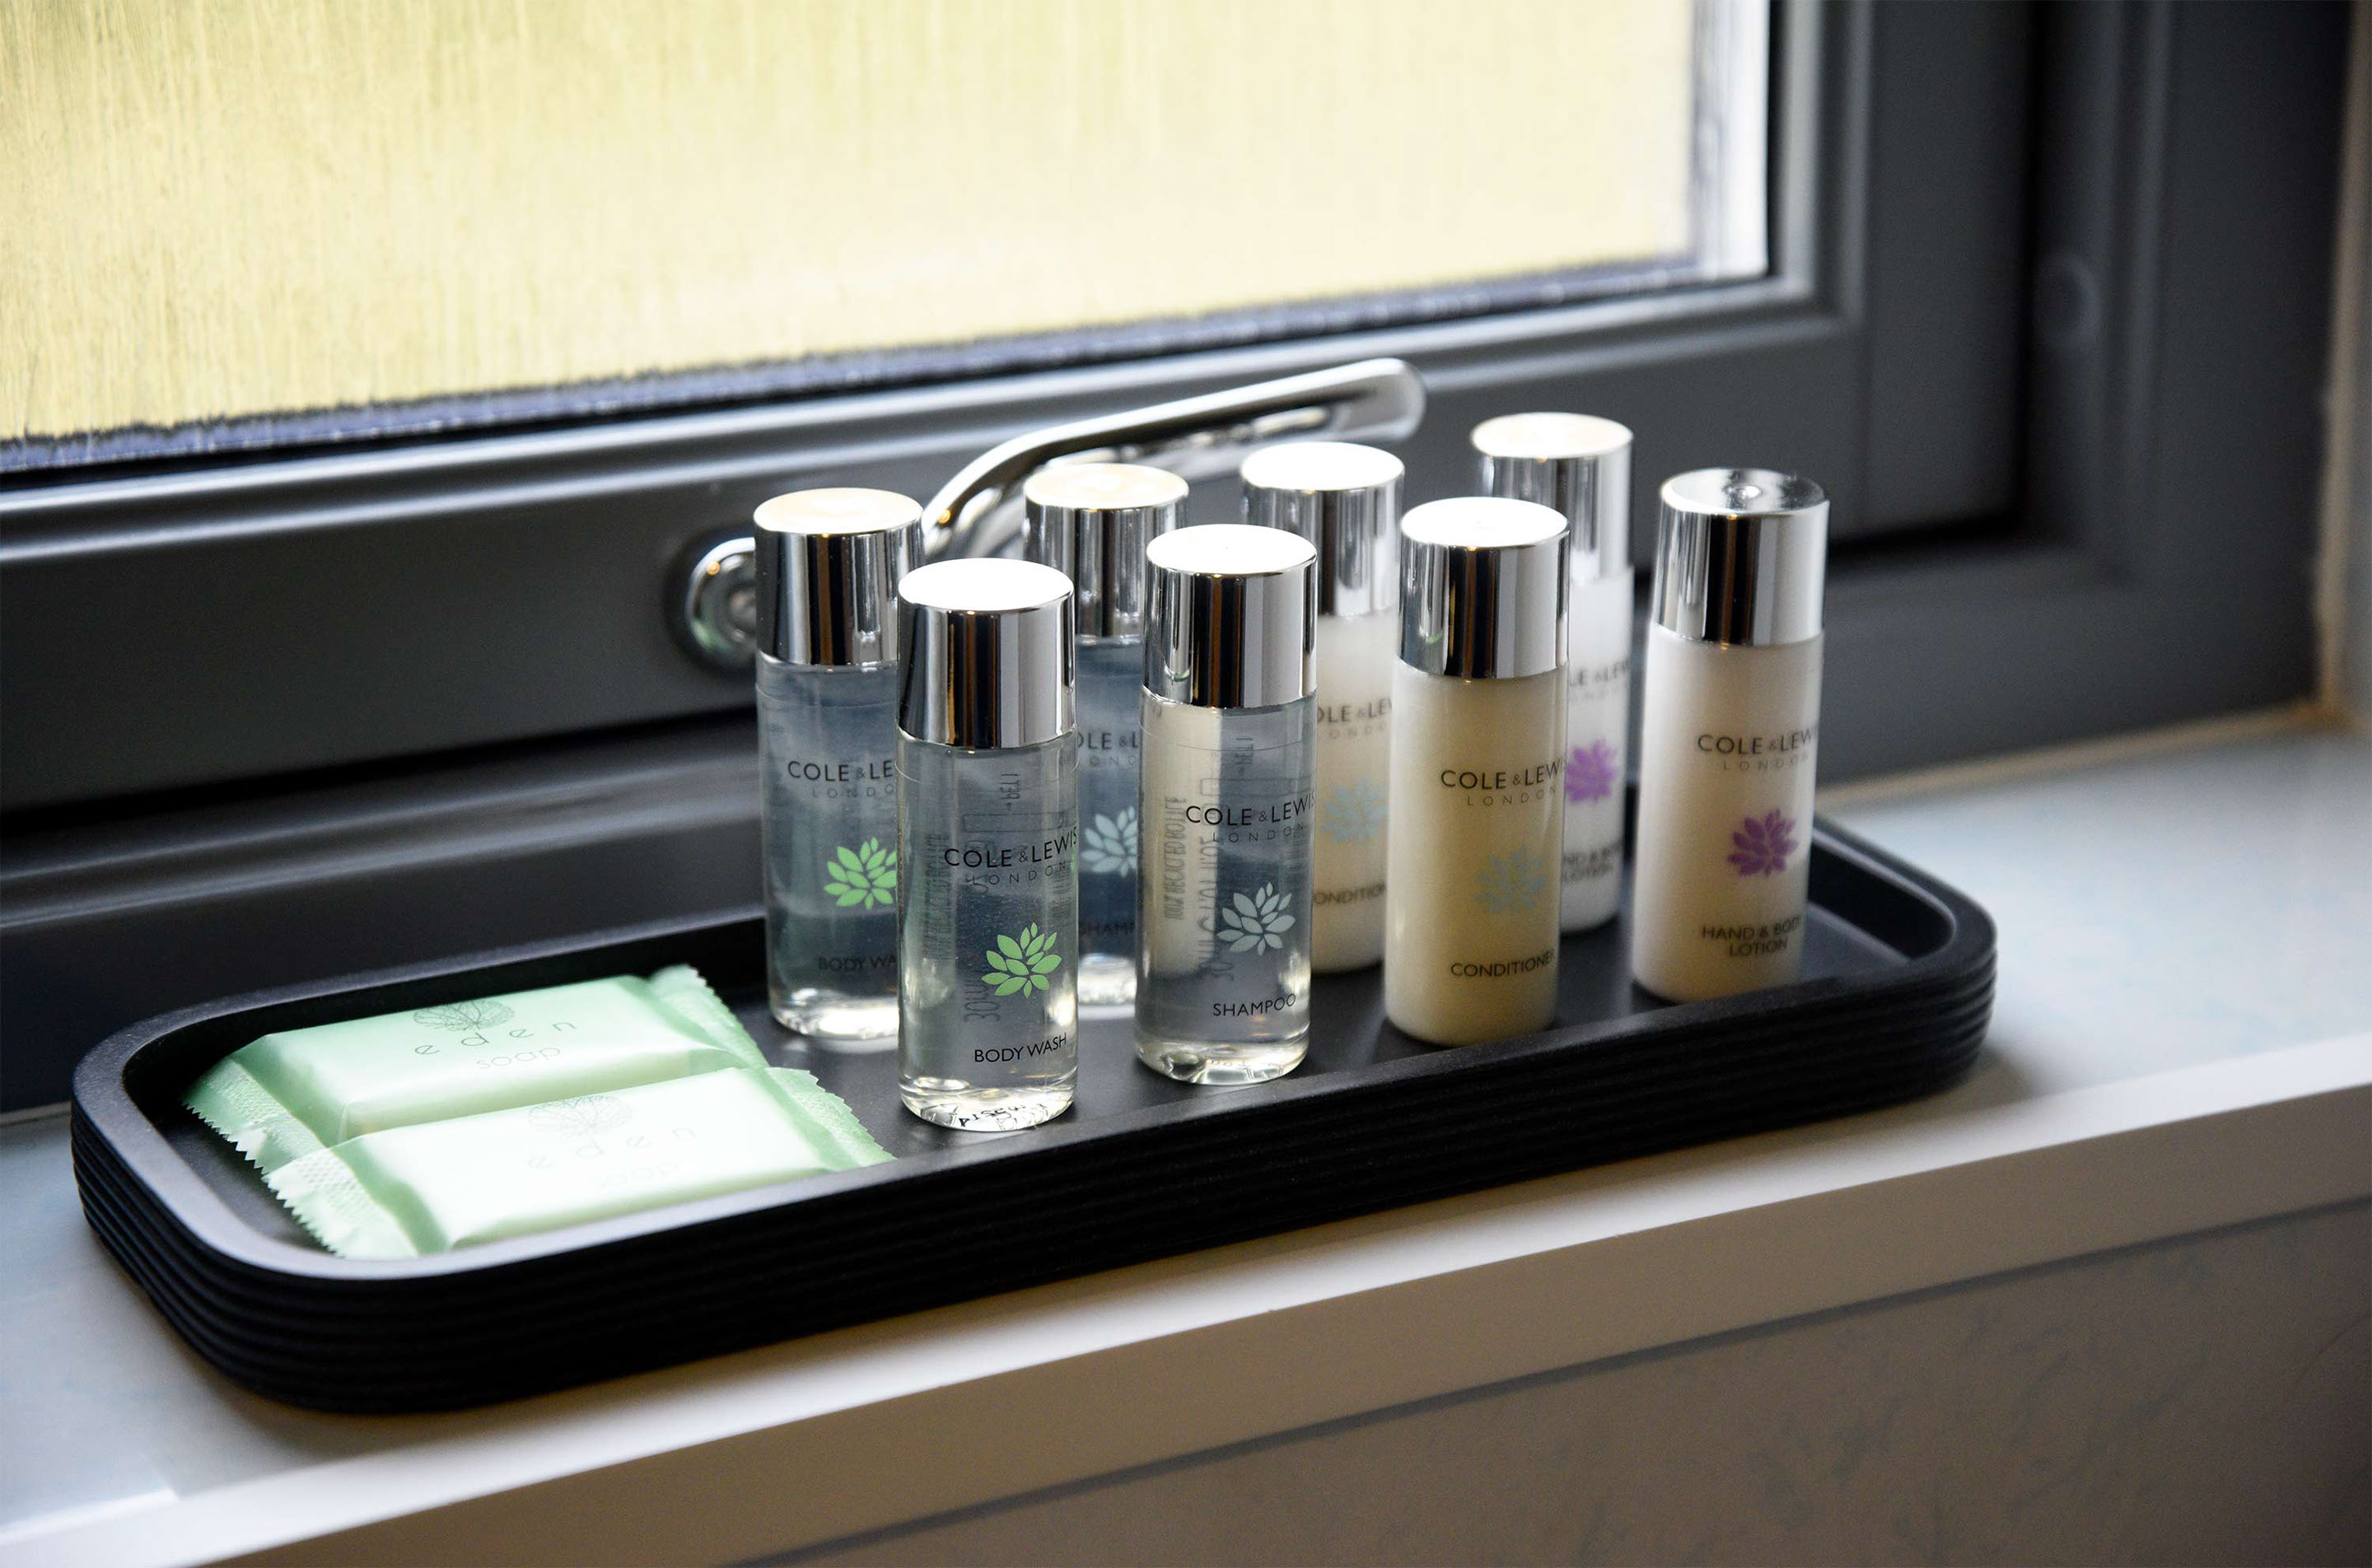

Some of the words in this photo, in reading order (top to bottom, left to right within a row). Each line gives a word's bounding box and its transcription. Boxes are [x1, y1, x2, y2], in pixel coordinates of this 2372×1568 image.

[1698, 734, 1763, 755] COLE
[787, 760, 850, 782] COLE
[857, 767, 866, 779] &
[1440, 770, 1506, 791] COLE
[1512, 773, 1521, 786] &
[812, 783, 895, 799] LONDO
[1468, 785, 1557, 807] LONDON
[1185, 805, 1253, 826] COLE
[1258, 810, 1268, 823] &
[1212, 821, 1305, 843] LONDON
[944, 848, 1013, 868] COLE
[1018, 850, 1029, 863] &
[1031, 825, 1077, 863] LEWIS
[972, 860, 1067, 886] LONDON
[869, 954, 898, 970] WA
[1212, 992, 1296, 1017] SHAMPOO
[413, 1021, 578, 1055] eden
[974, 1046, 1025, 1062] BODY
[1026, 1032, 1067, 1057] WASH
[475, 1047, 562, 1070] soap
